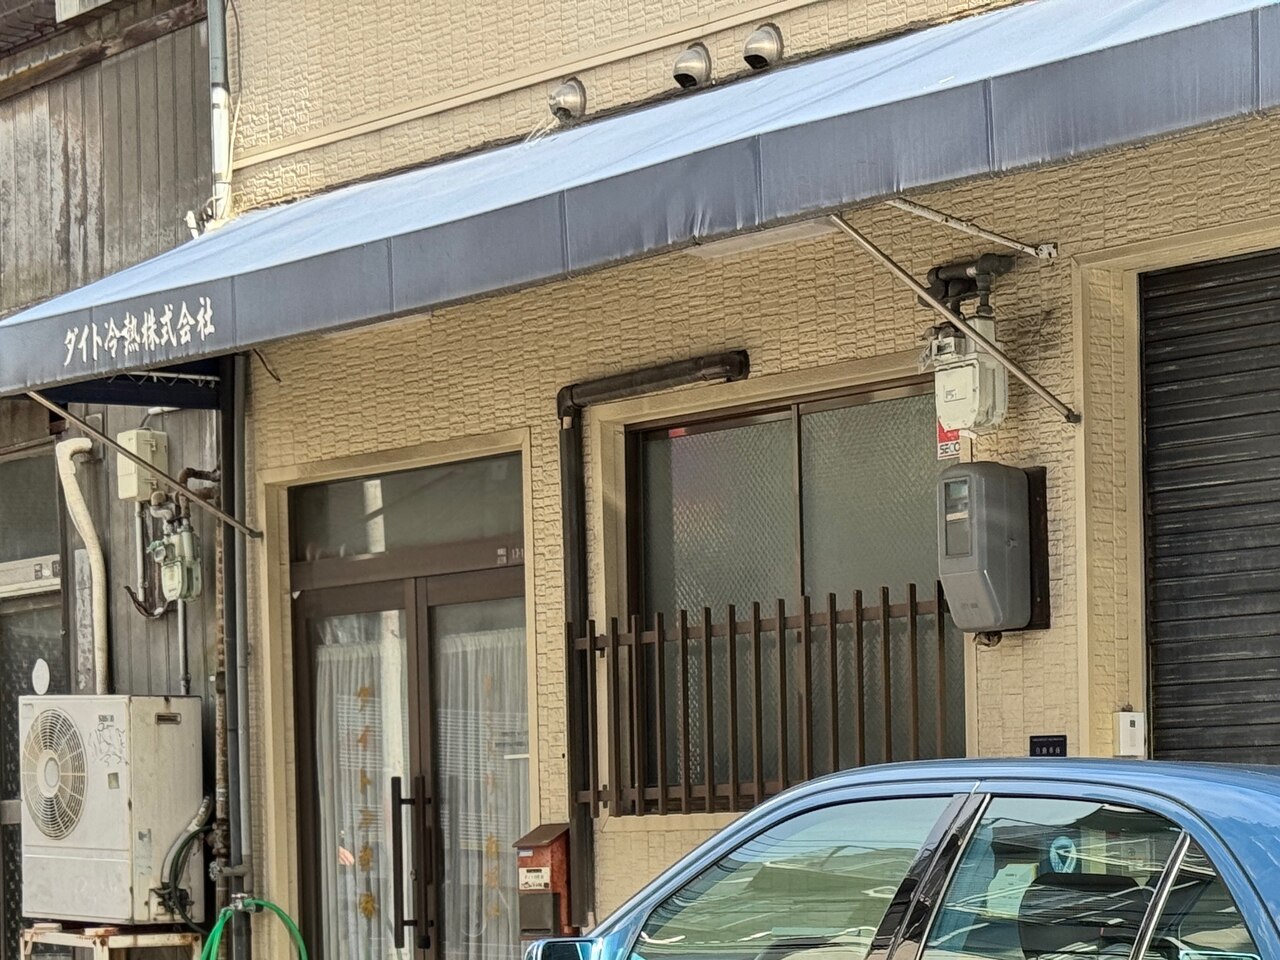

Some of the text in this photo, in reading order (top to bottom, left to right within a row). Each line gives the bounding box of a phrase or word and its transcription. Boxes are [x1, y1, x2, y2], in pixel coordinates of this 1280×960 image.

[63, 297, 215, 366] ダイト冷熱株式会社
[940, 441, 960, 455] SECO
